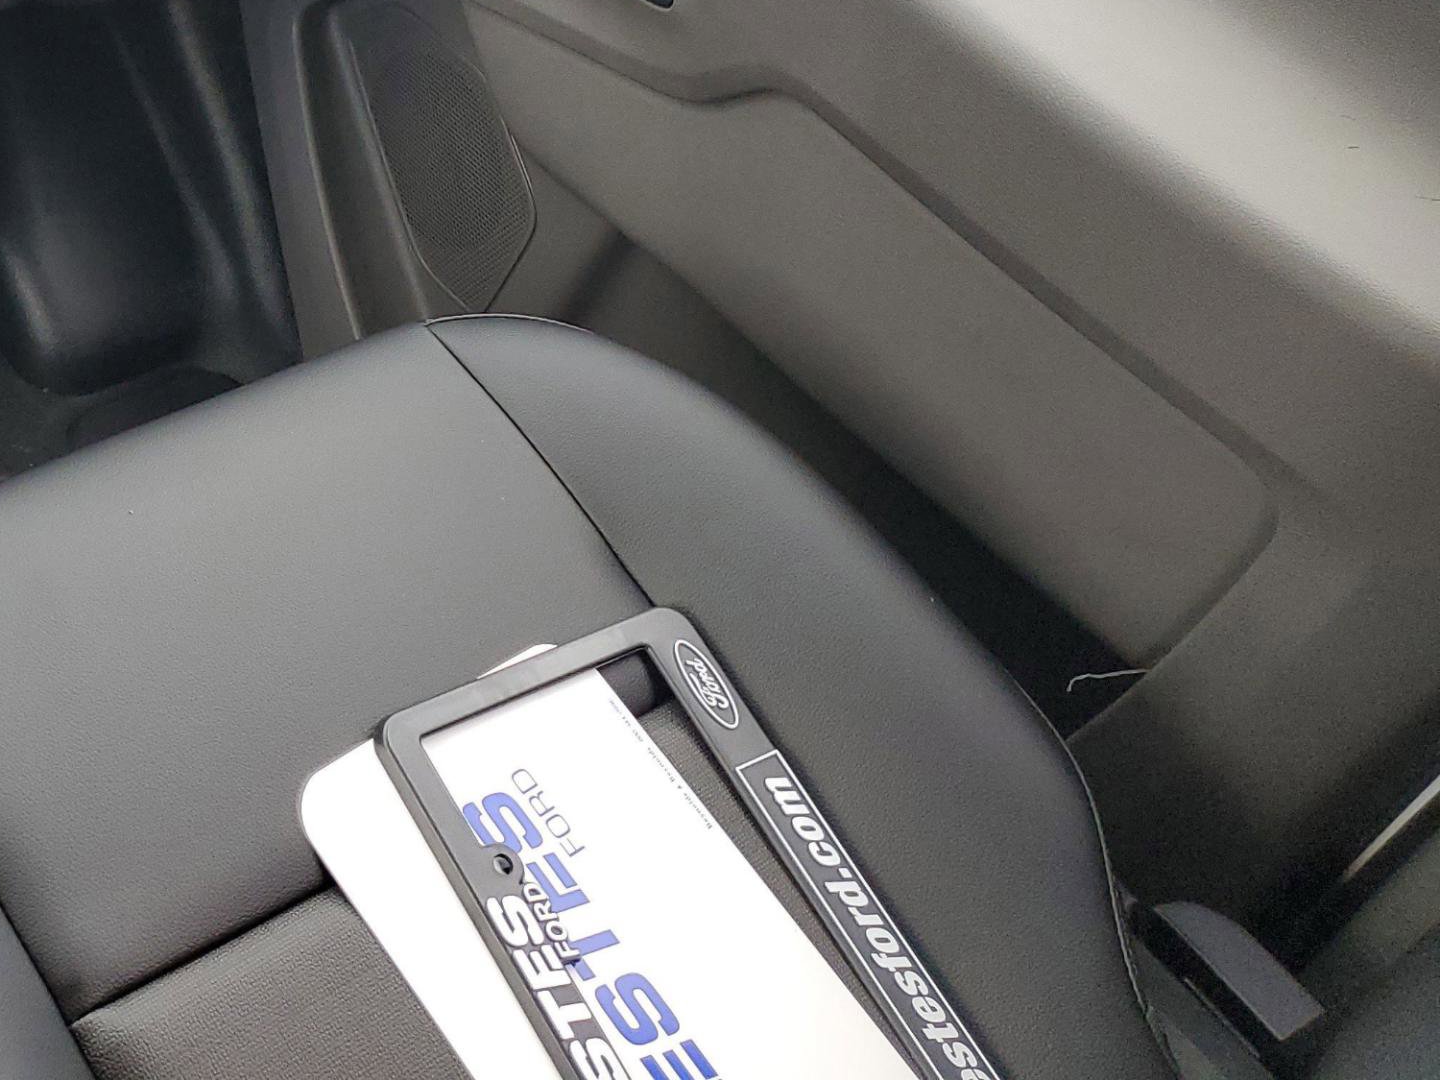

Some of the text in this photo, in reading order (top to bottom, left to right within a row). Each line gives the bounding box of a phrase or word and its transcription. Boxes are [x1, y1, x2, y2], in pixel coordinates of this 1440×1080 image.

[686, 657, 730, 710] Ford
[511, 768, 586, 858] FORD
[522, 882, 581, 961] FORD
